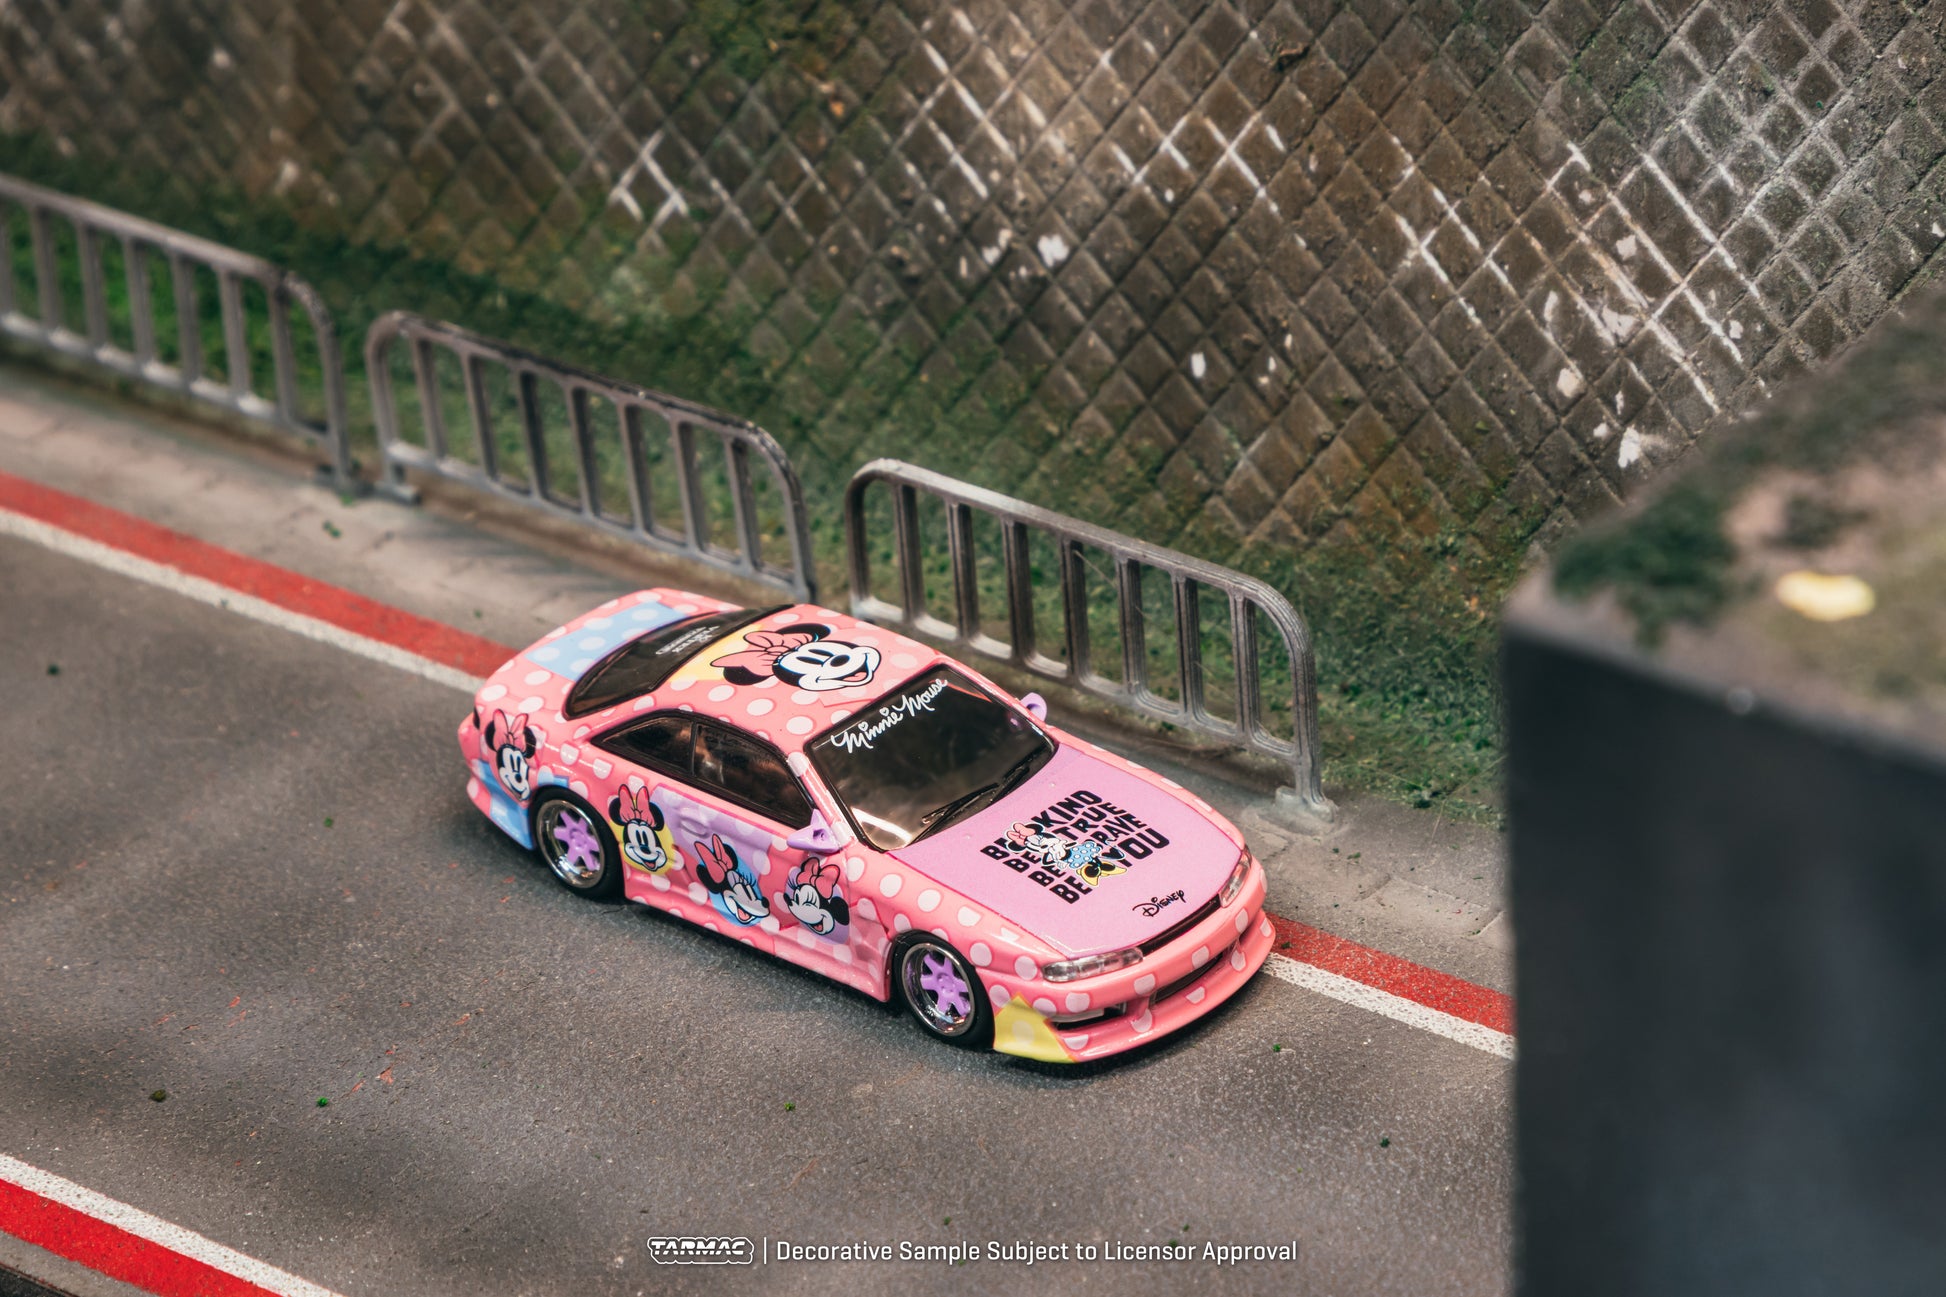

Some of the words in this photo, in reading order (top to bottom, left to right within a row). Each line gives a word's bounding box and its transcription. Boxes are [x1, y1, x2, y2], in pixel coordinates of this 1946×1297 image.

[831, 707, 903, 753] Minnie
[892, 679, 948, 716] Mouse
[1002, 851, 1042, 873] BE
[1052, 802, 1127, 840] TRUE
[1031, 790, 1102, 828] KIND
[1028, 865, 1066, 887] BE
[1085, 813, 1147, 849] RAVE
[1049, 876, 1093, 904] BE
